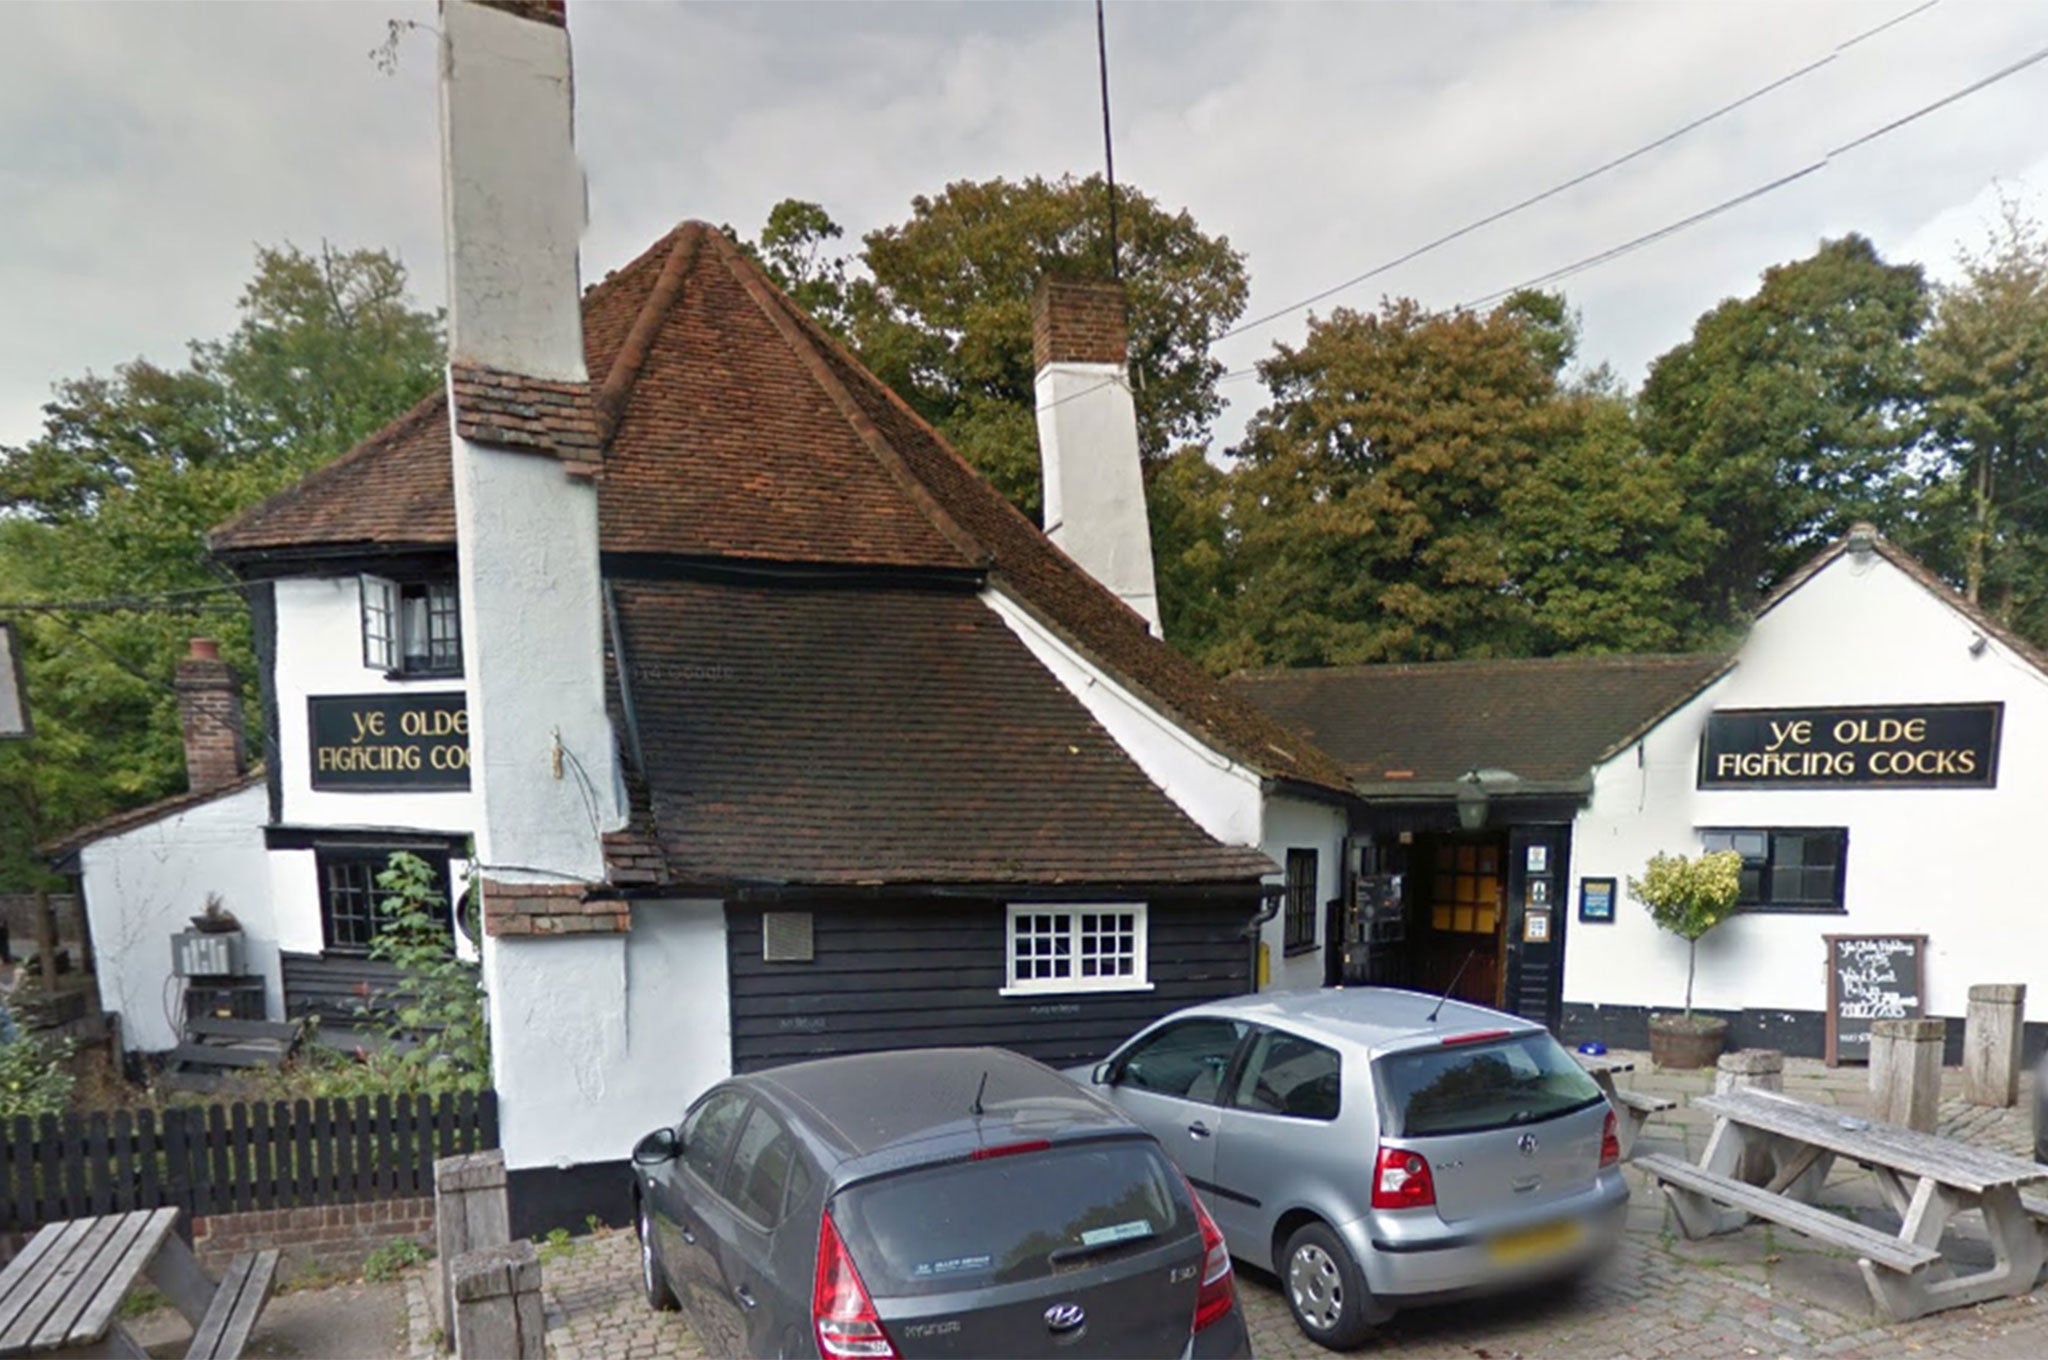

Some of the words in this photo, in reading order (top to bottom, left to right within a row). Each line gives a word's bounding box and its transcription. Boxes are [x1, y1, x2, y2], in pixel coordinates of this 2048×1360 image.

[351, 711, 386, 744] YE
[401, 709, 469, 736] OLDE
[1765, 720, 1813, 751] YE
[1833, 718, 1927, 744] OLDE
[317, 744, 422, 771] FIGHTING
[430, 744, 472, 770] CO
[1717, 751, 1855, 776] FIGHTING
[1868, 749, 1976, 775] COCKS
